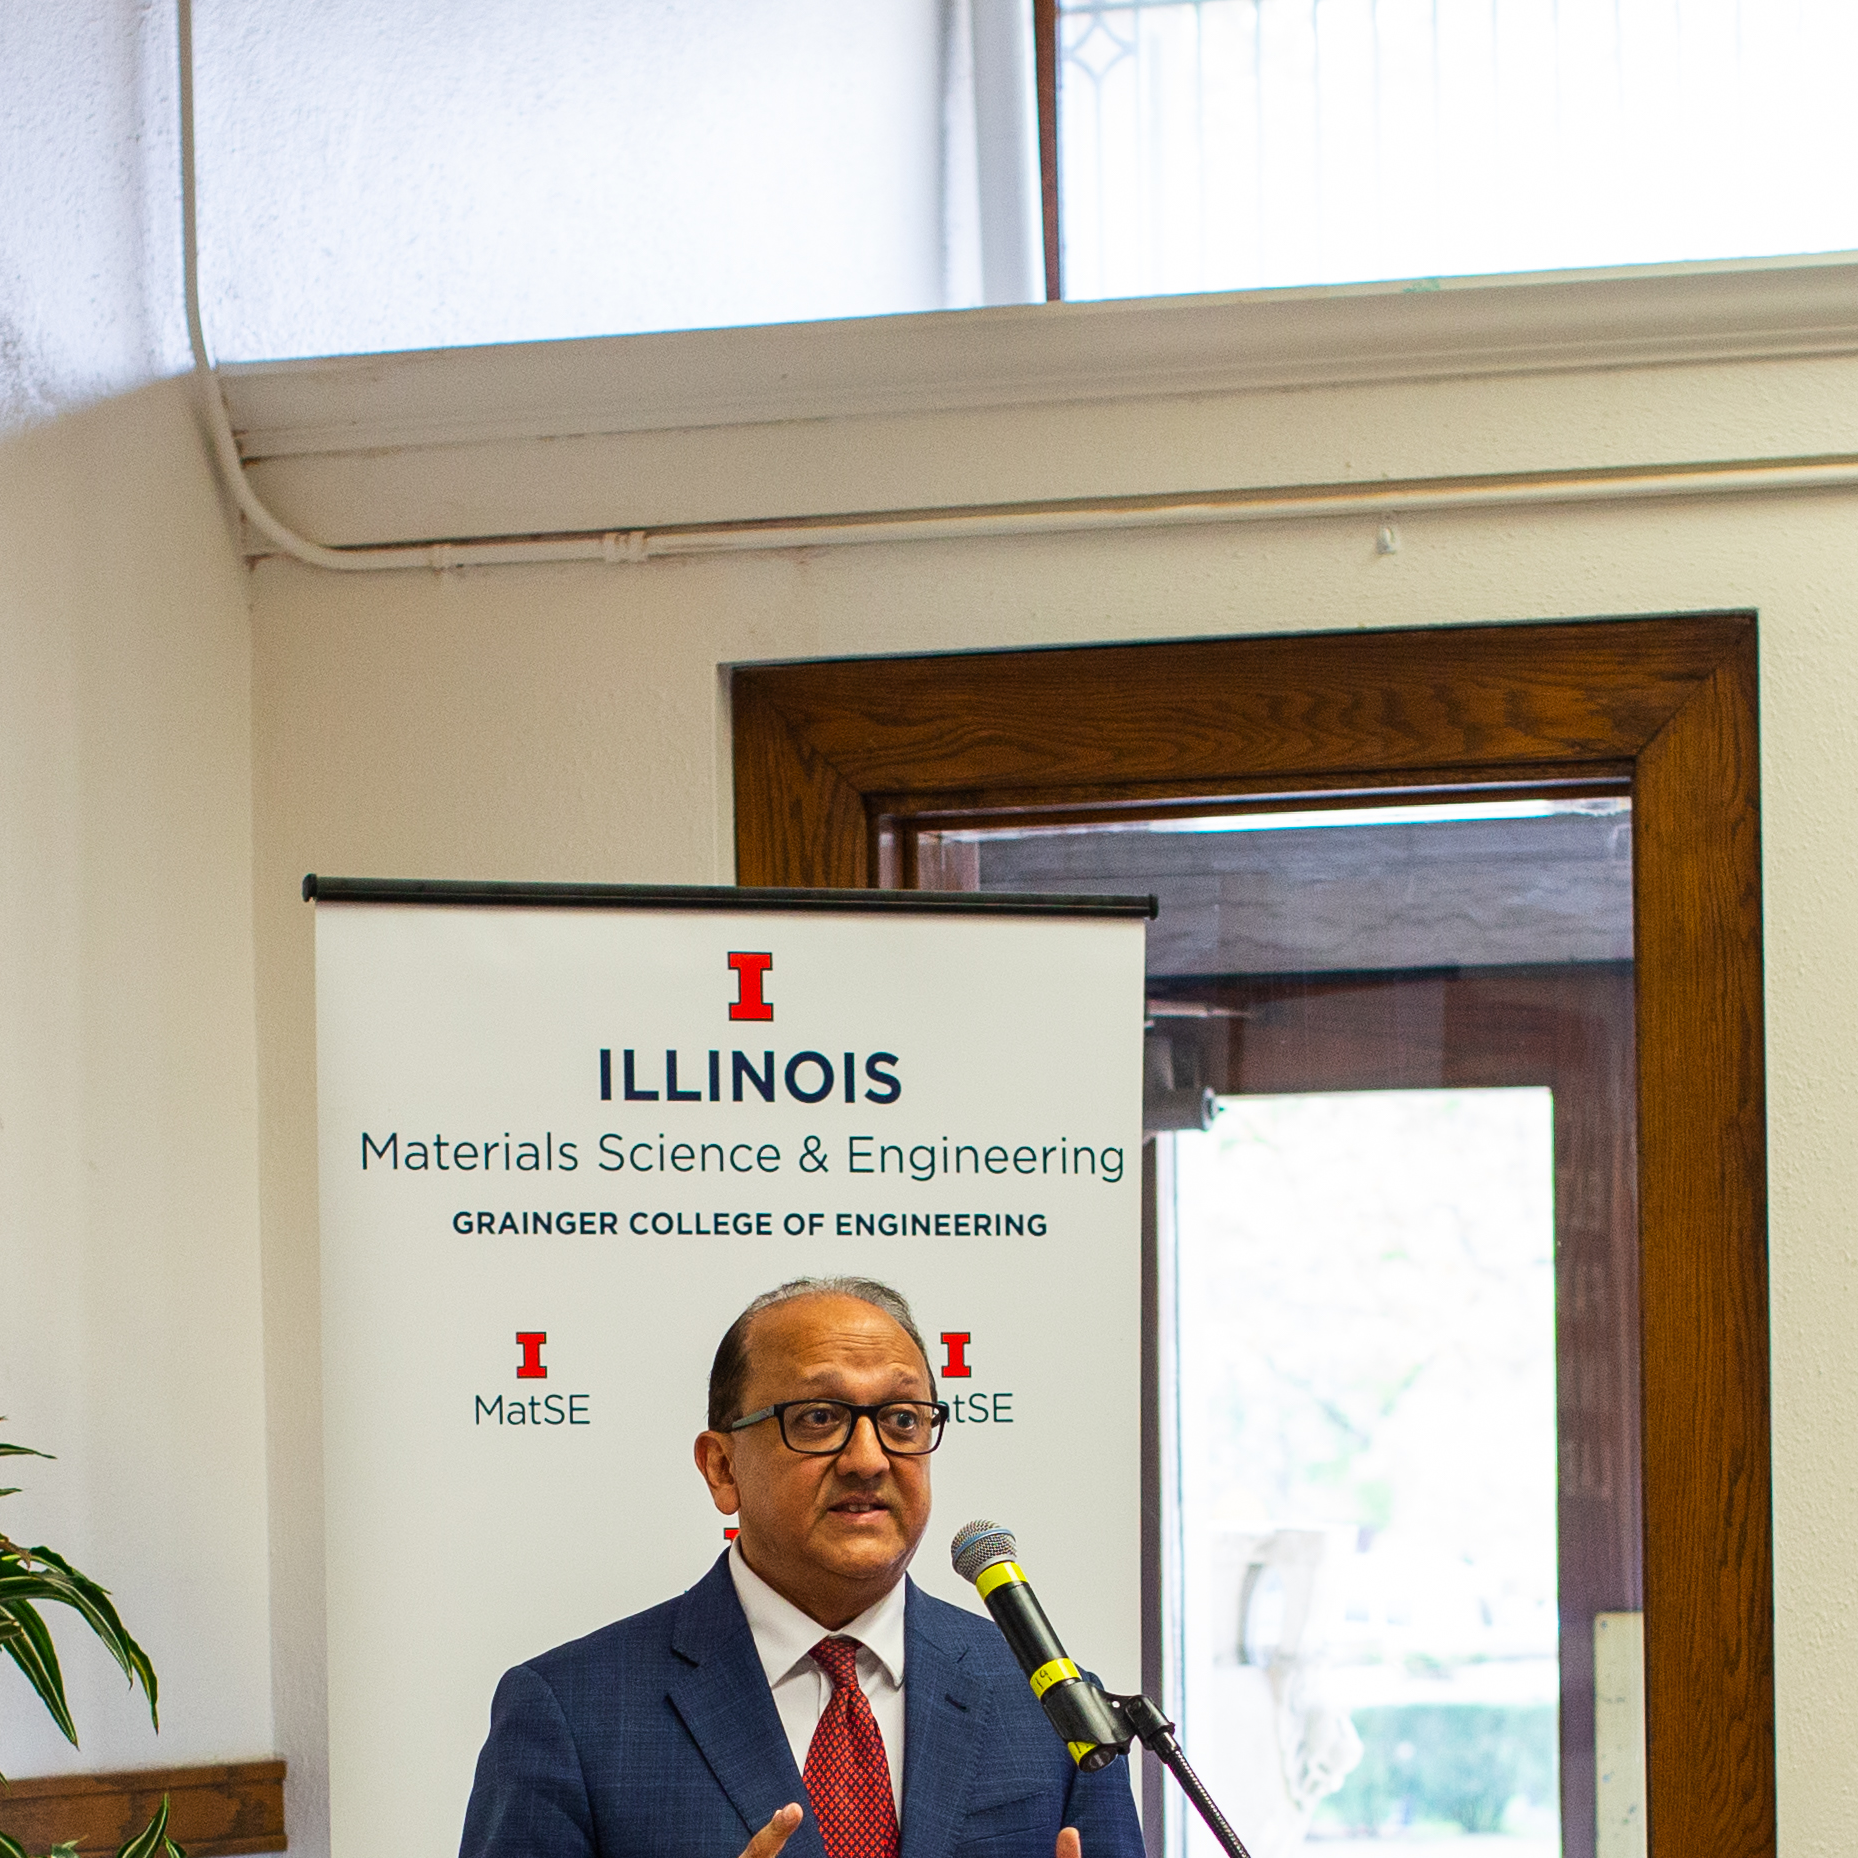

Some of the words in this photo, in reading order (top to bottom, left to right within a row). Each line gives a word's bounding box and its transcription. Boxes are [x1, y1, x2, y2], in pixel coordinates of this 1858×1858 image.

[599, 1049, 902, 1104] ILLINOIS
[361, 1131, 579, 1172] Materials
[598, 1133, 781, 1173] Science
[799, 1135, 829, 1173] &
[849, 1135, 1125, 1182] Engineering
[452, 1211, 618, 1235] GRAINGER
[629, 1212, 773, 1236] COLLEGE
[783, 1213, 825, 1236] OF
[836, 1213, 1047, 1237] ENGINEERING
[475, 1394, 591, 1425] MatSE
